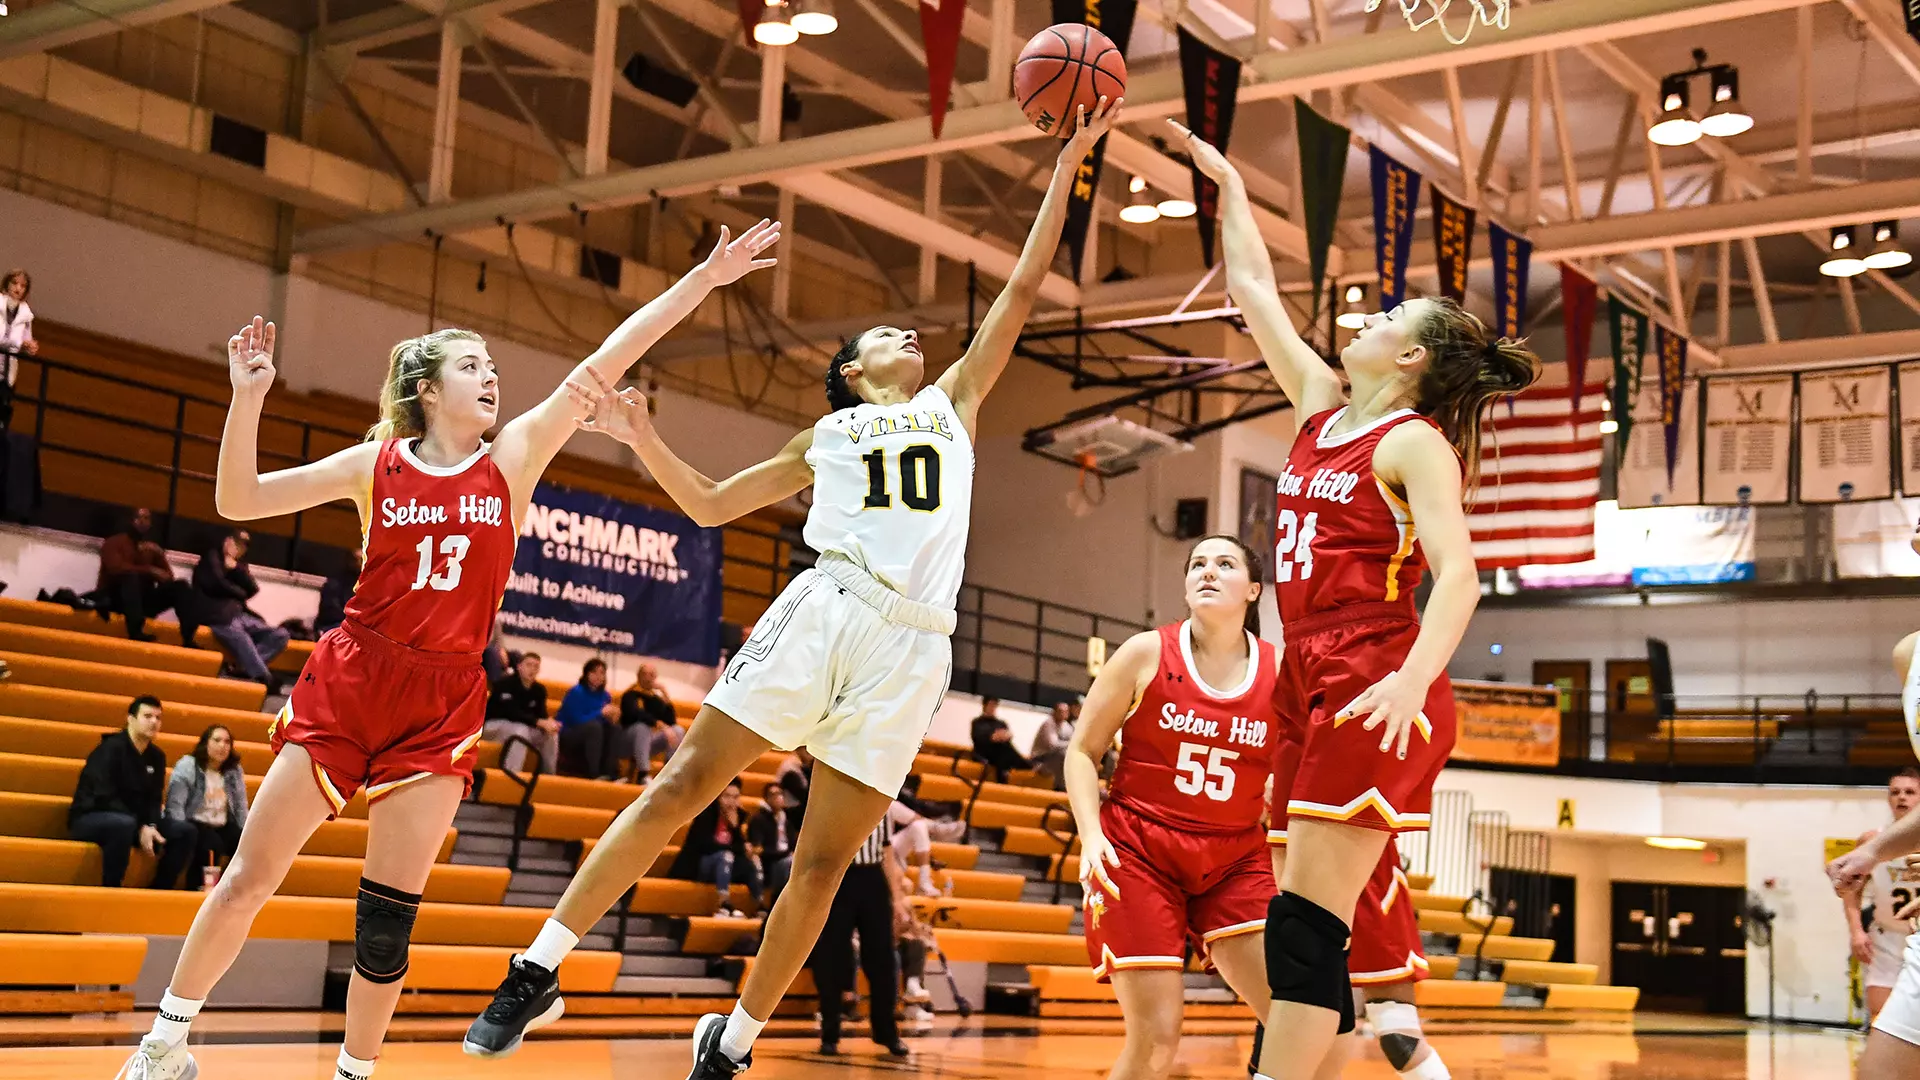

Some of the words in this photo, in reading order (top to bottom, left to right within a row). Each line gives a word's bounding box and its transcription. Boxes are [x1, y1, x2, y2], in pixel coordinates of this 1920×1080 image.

[846, 410, 954, 444] VILLE
[861, 443, 943, 514] 10
[1276, 464, 1305, 498] ton
[1305, 467, 1360, 505] Hill
[381, 497, 448, 528] Seton
[458, 494, 503, 527] Hill
[519, 502, 679, 567] NCHMARK
[1275, 508, 1319, 583] 24
[410, 534, 472, 592] 13
[541, 576, 561, 600] to
[561, 580, 626, 612] Achieve
[1158, 702, 1220, 738] Seton
[1227, 716, 1268, 748] Hill
[1173, 741, 1241, 802] 55
[1557, 800, 1574, 827] A
